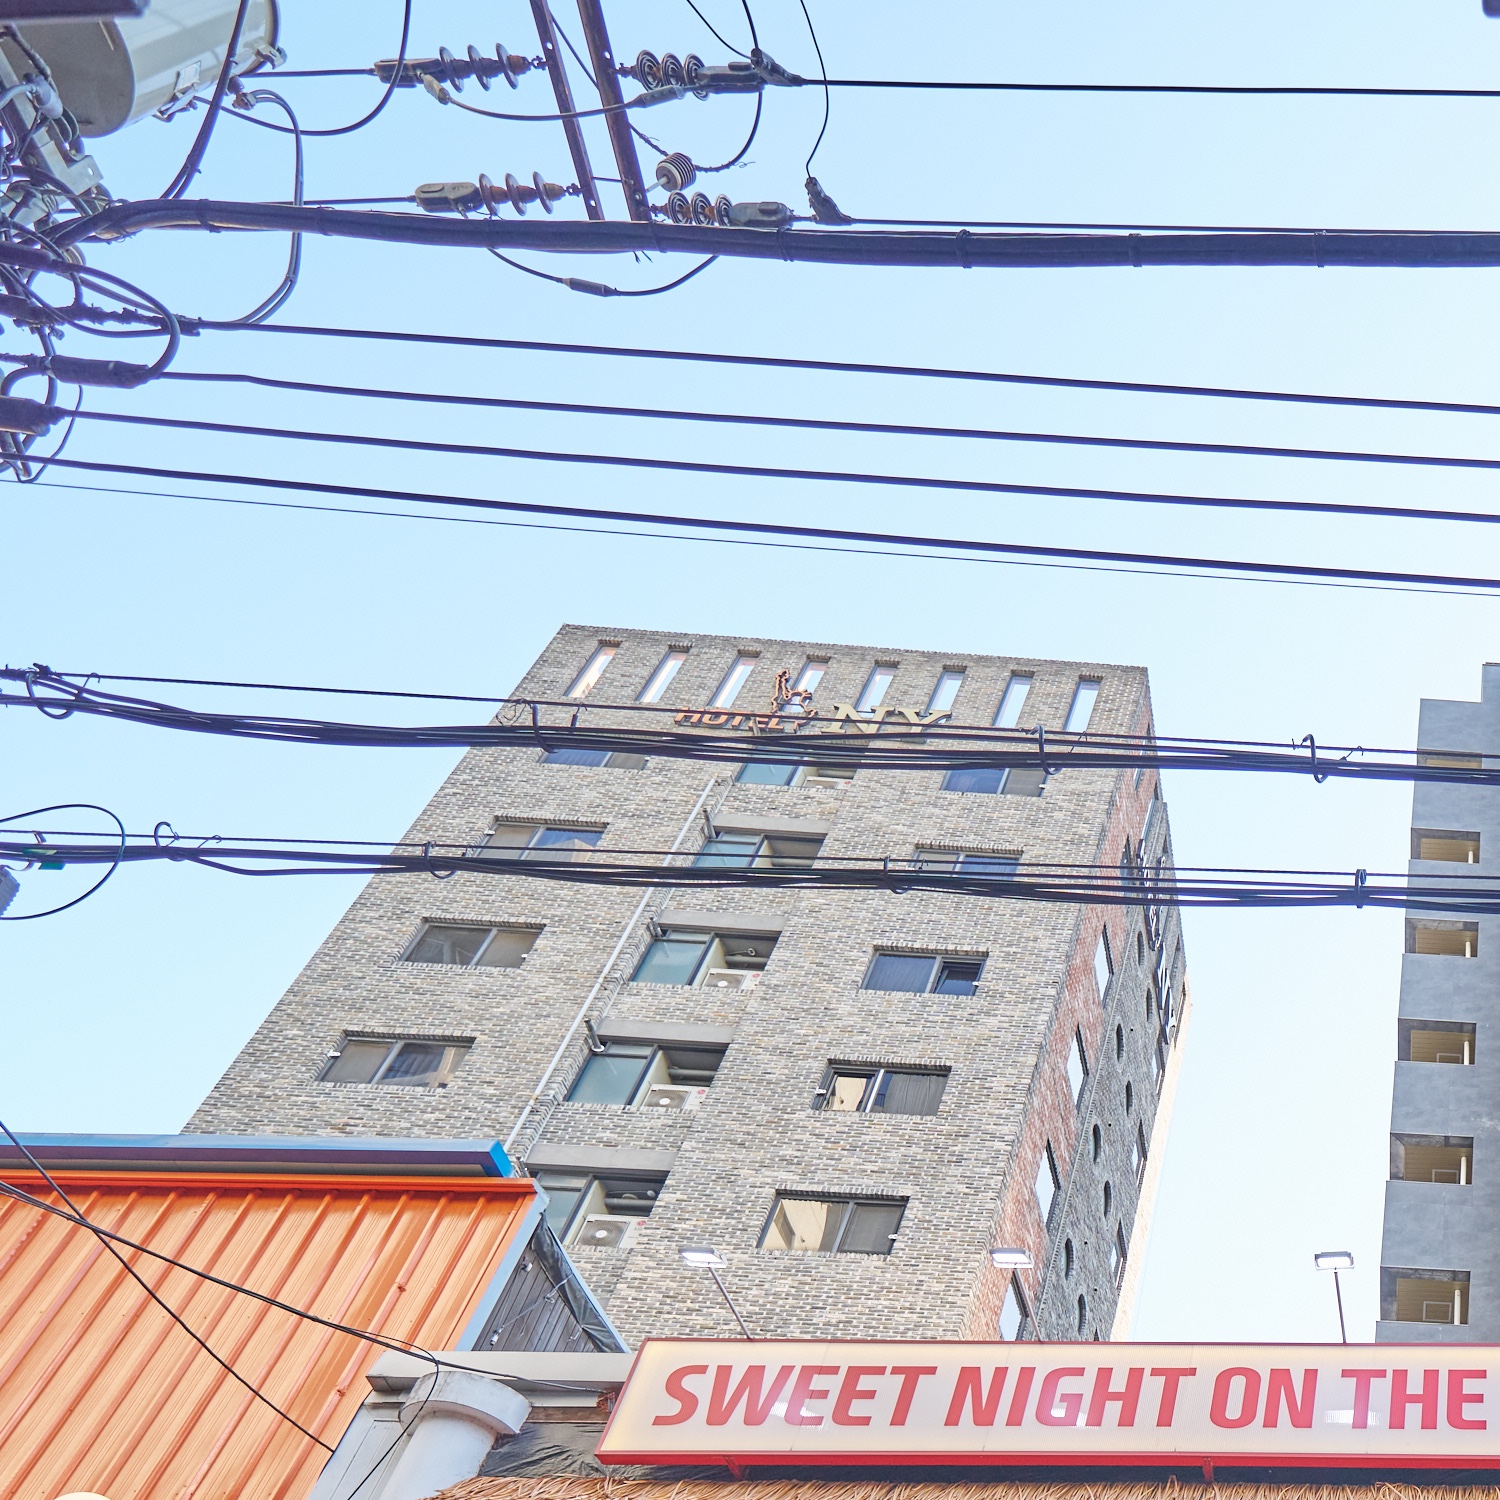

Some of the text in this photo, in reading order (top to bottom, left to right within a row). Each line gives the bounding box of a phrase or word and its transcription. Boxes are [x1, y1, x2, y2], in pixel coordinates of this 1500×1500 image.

[820, 703, 954, 735] NY
[651, 1364, 938, 1427] SWEET
[943, 1365, 1198, 1428] NIGHT
[1208, 1366, 1319, 1429] ON
[1340, 1368, 1488, 1431] THE
